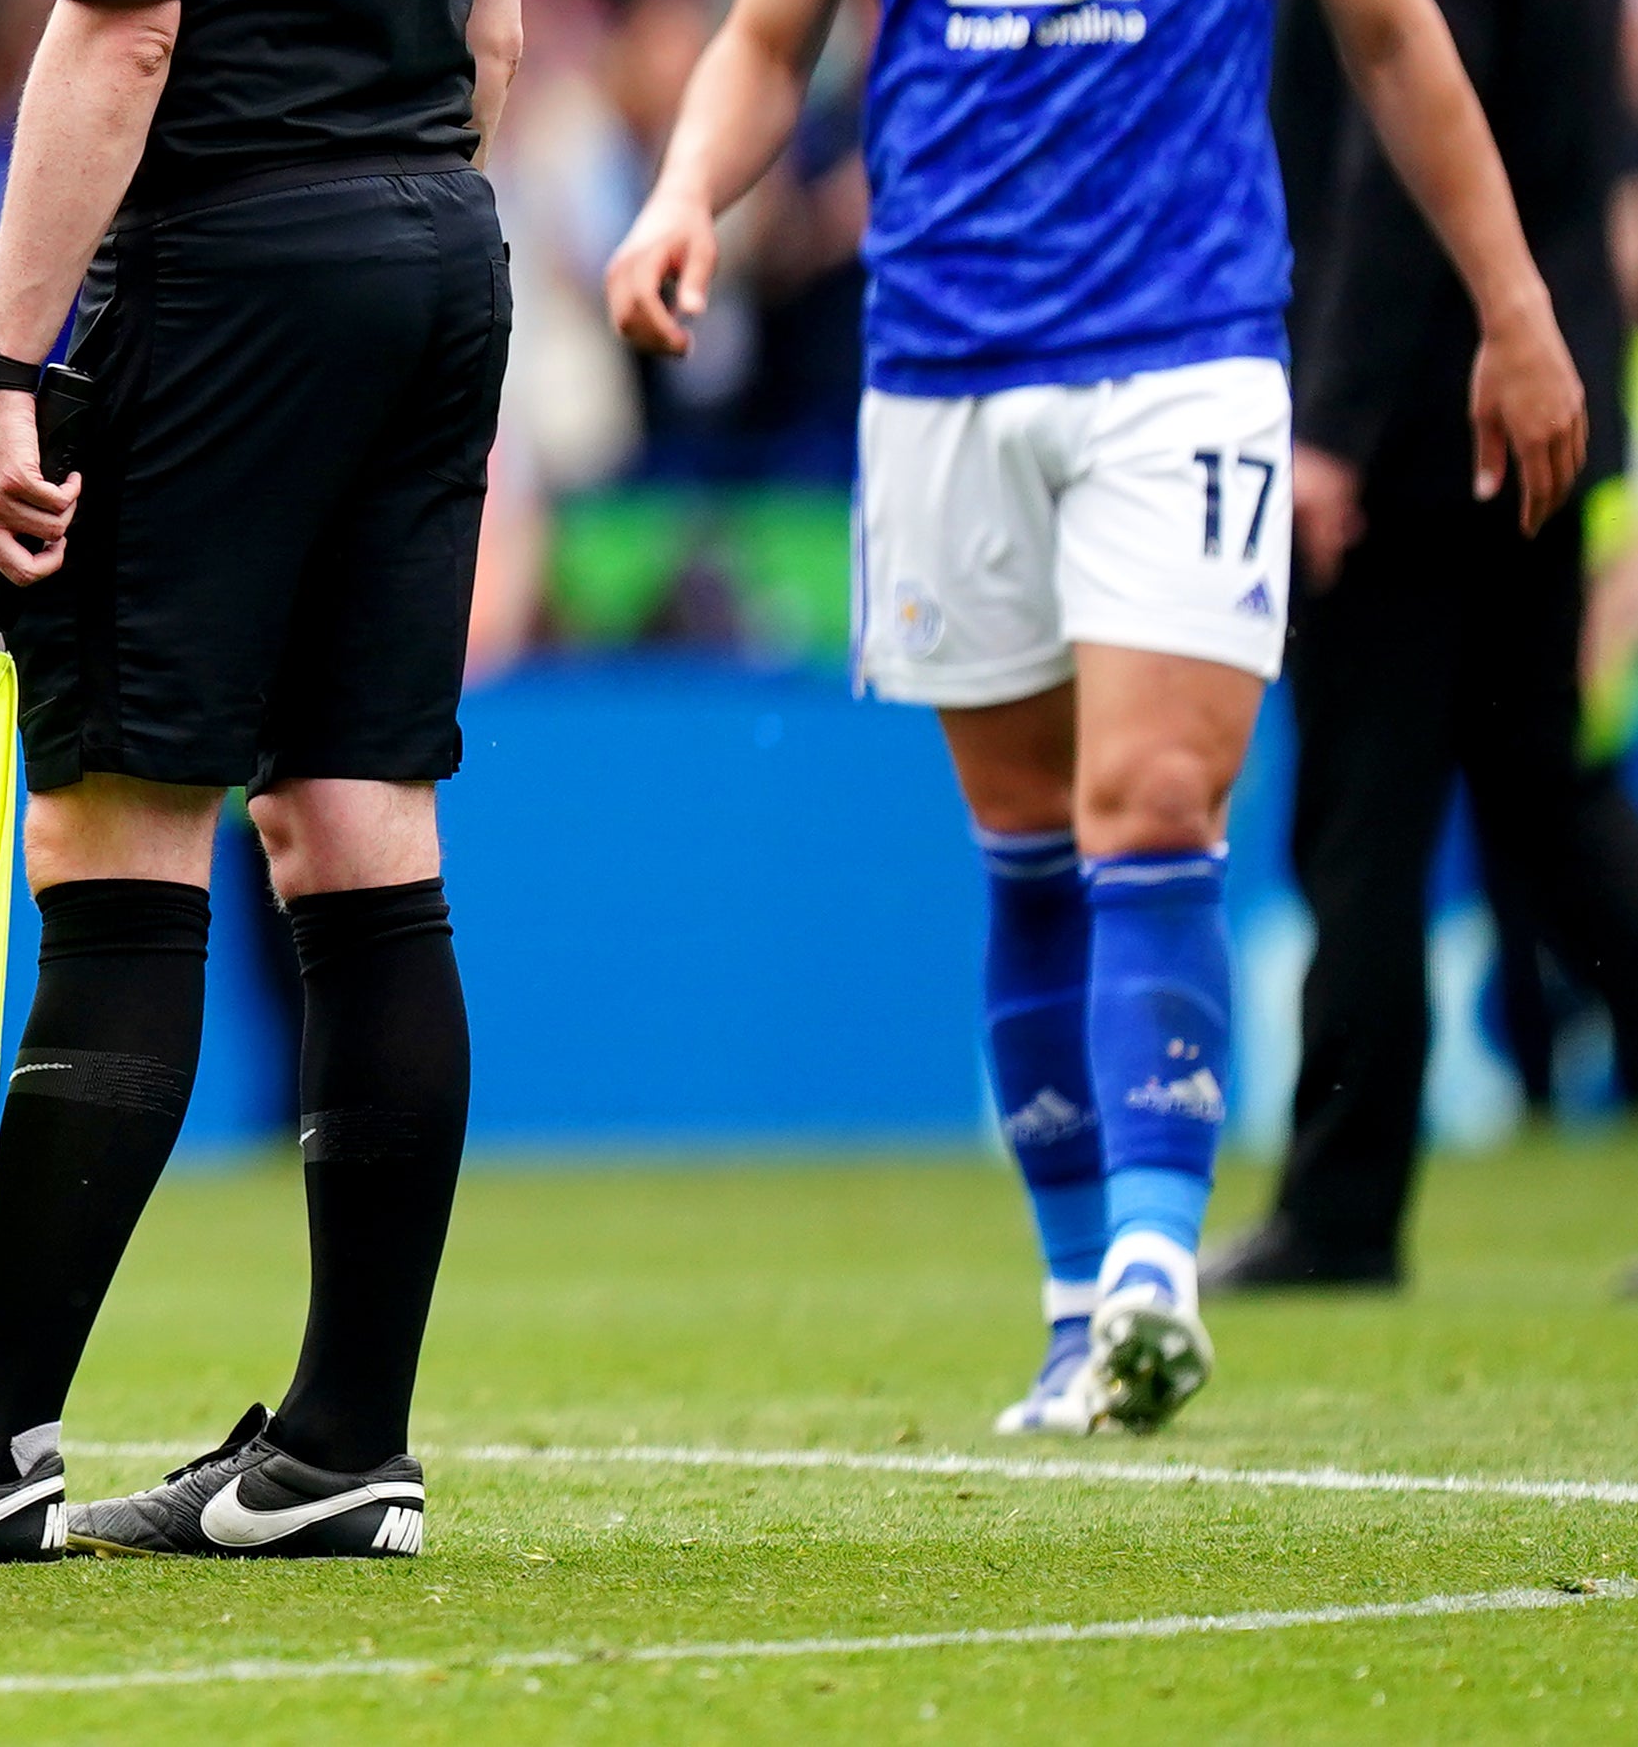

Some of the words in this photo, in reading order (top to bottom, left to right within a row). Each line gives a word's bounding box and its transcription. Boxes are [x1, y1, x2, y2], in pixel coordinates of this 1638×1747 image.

[944, 11, 1031, 50] trade
[1034, 2, 1147, 48] online
[1193, 451, 1275, 560] 17
